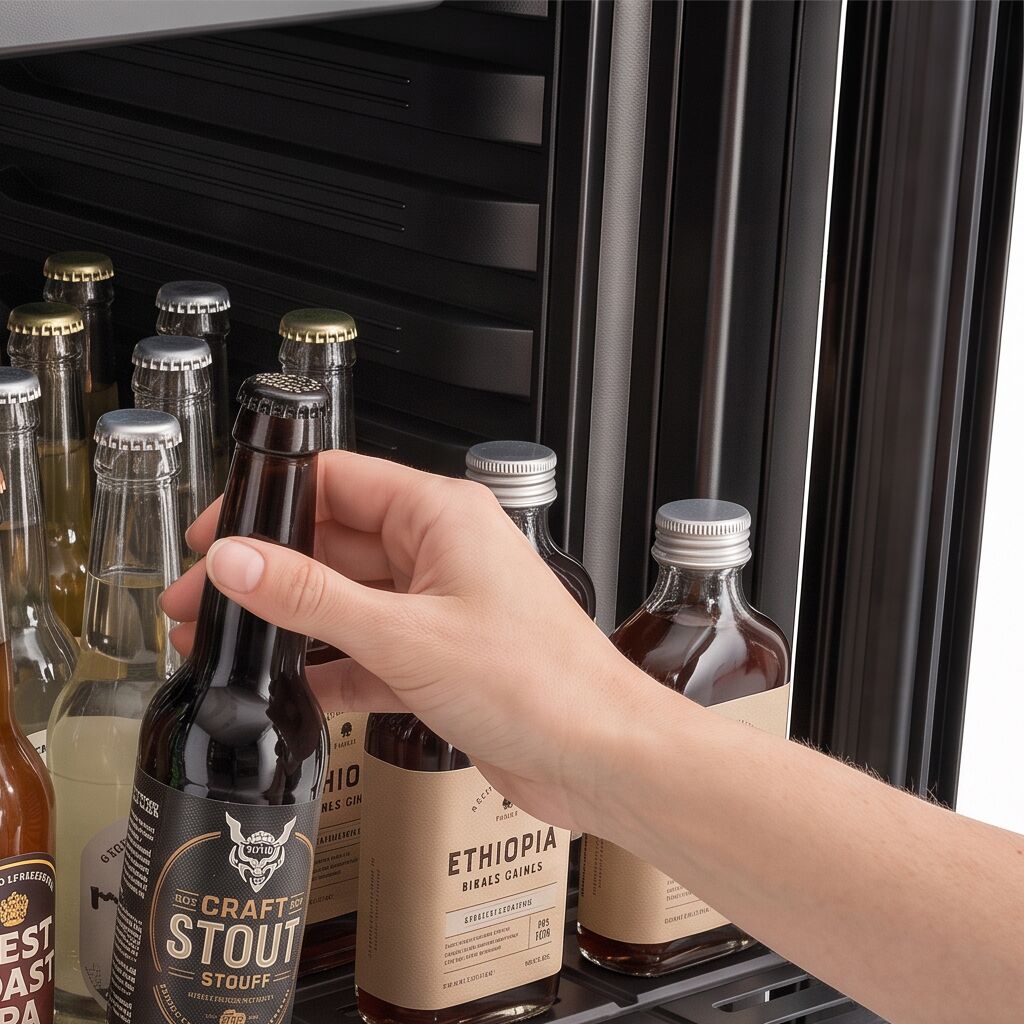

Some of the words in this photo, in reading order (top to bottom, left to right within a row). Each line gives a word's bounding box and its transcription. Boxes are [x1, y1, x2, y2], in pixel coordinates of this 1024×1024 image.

[447, 825, 558, 877] ETHIOPIA
[201, 895, 289, 920] CRAFT
[166, 913, 301, 969] STOUT
[201, 972, 271, 990] STOUFF
